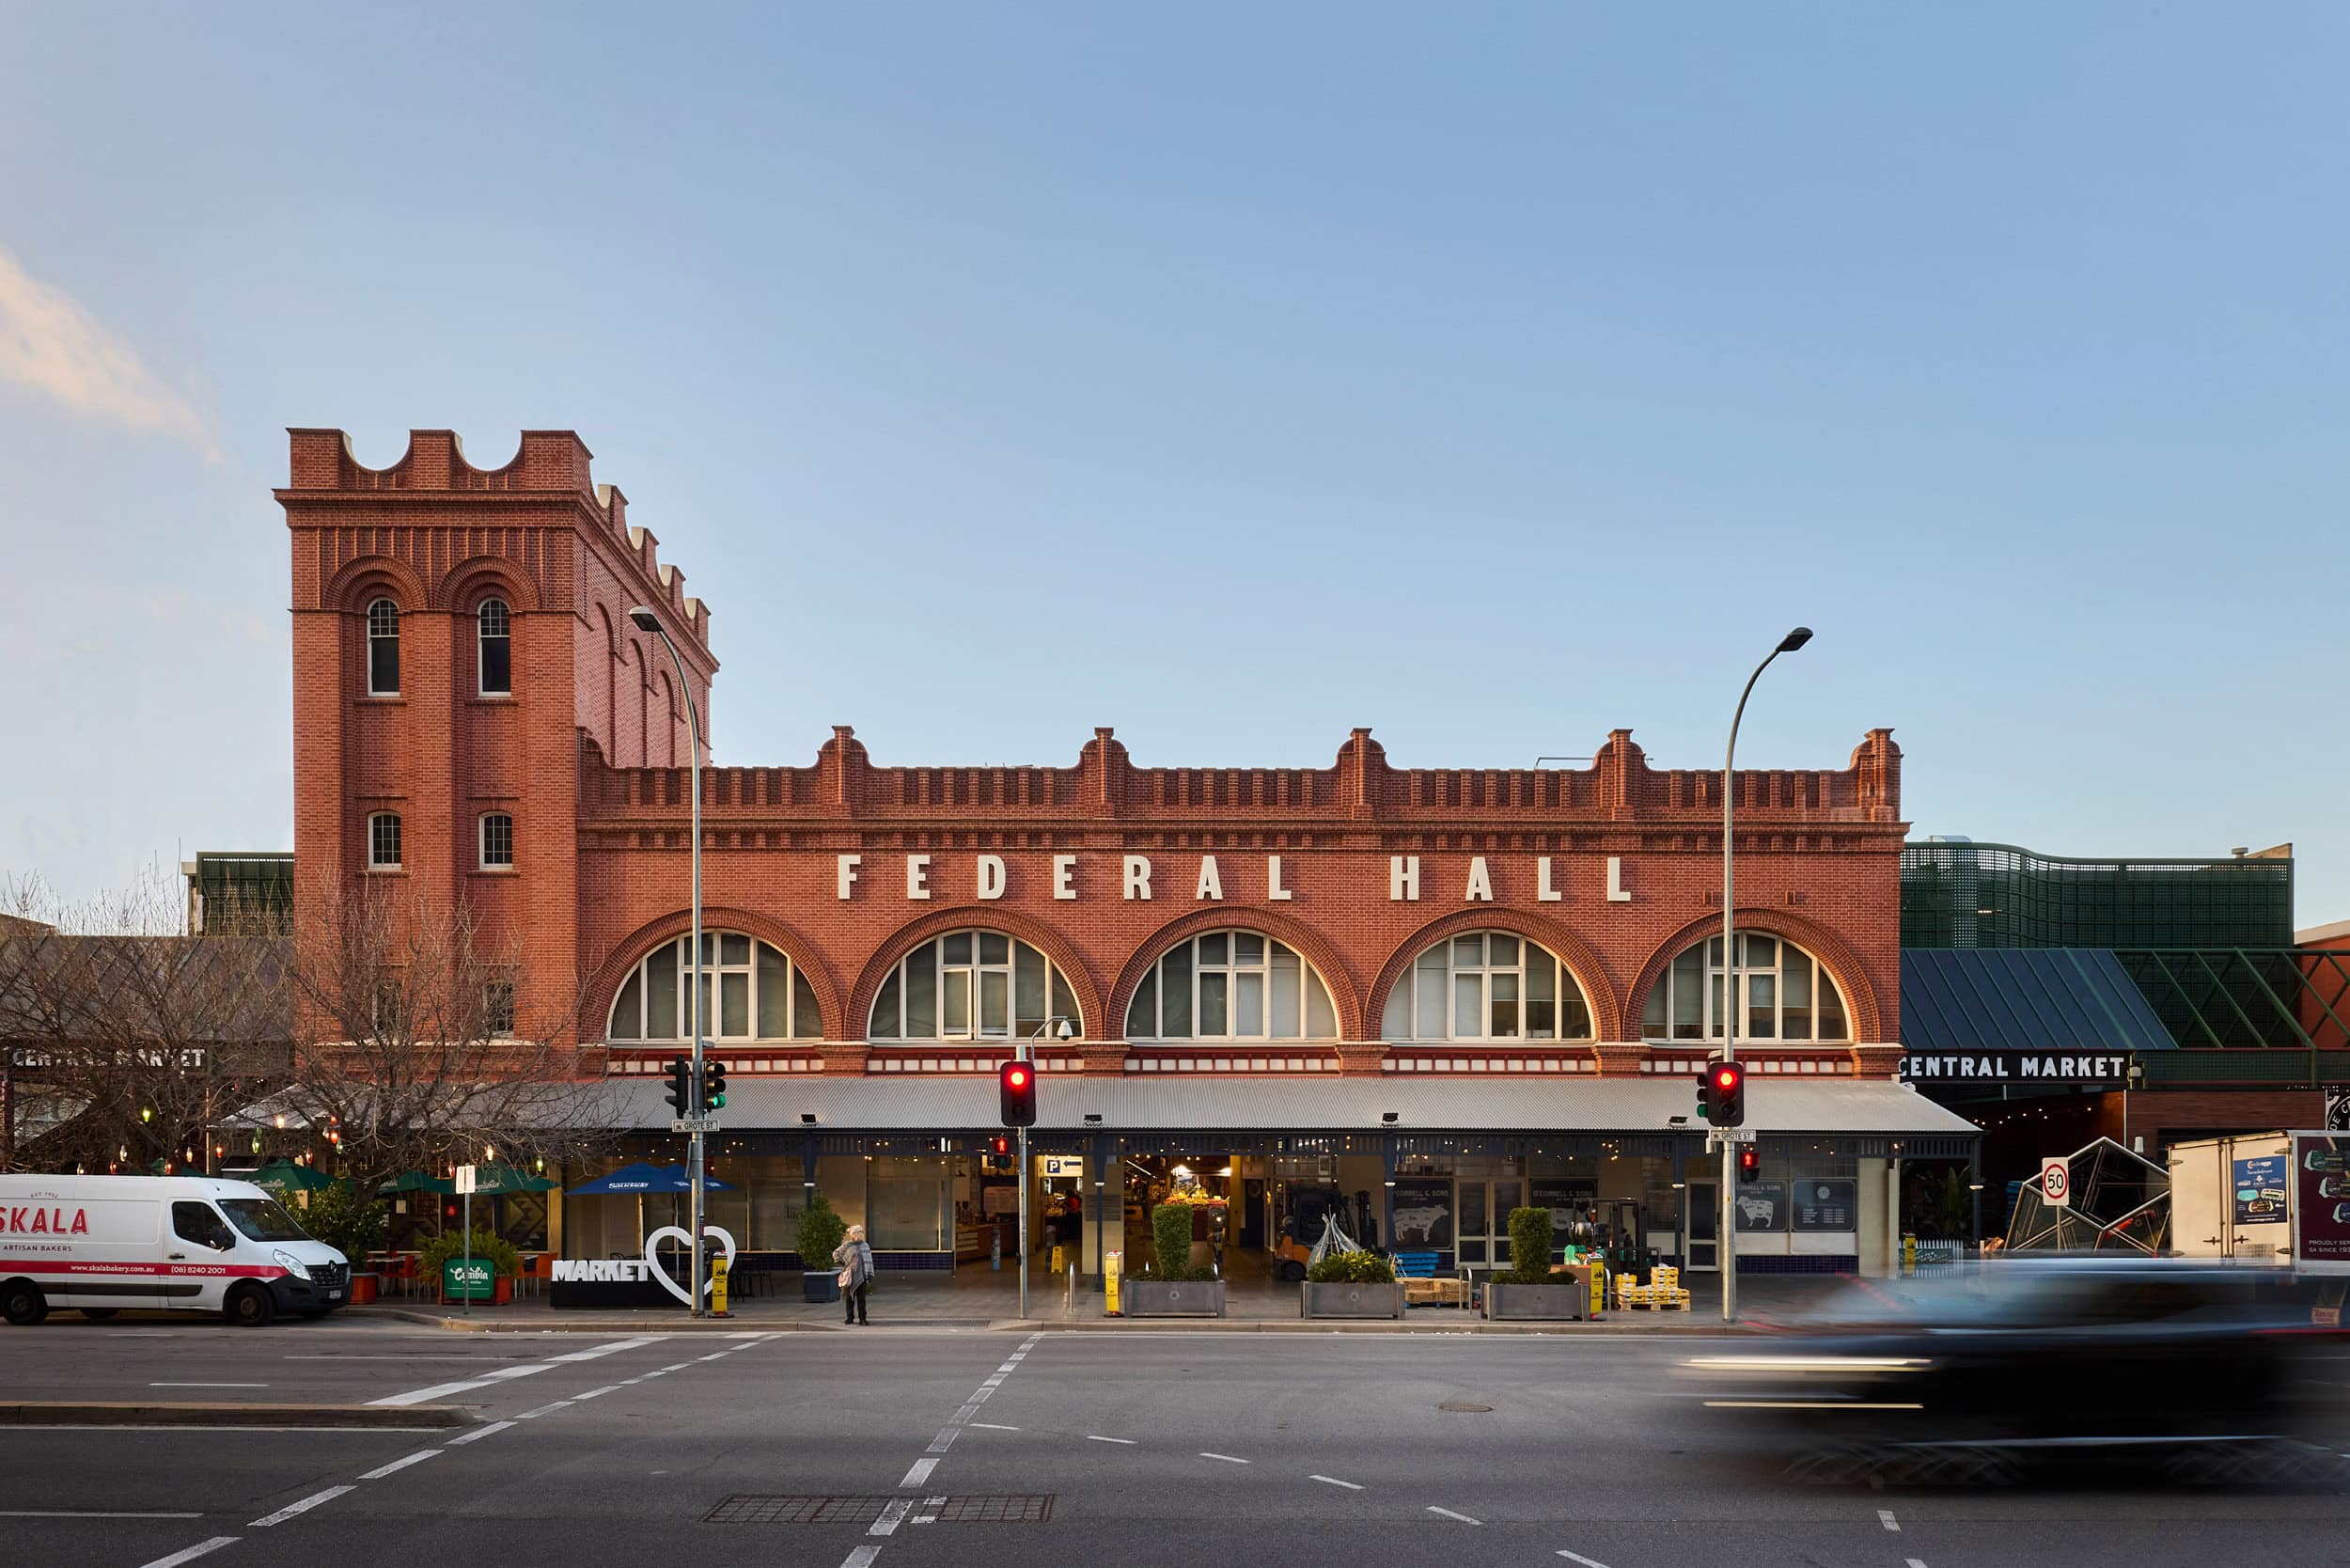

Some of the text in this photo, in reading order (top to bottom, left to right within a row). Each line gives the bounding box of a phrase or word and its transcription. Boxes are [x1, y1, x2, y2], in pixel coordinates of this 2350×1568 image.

[838, 855, 1632, 902] FEDERAL HALL
[1898, 1057, 2124, 1077] CENTRAL MARKET
[706, 1121, 714, 1130] ST
[2048, 1174, 2064, 1189] 50
[70, 1264, 155, 1274] www.skalabakery.com.au
[207, 1266, 226, 1275] 2001
[551, 1260, 650, 1282] MARKET
